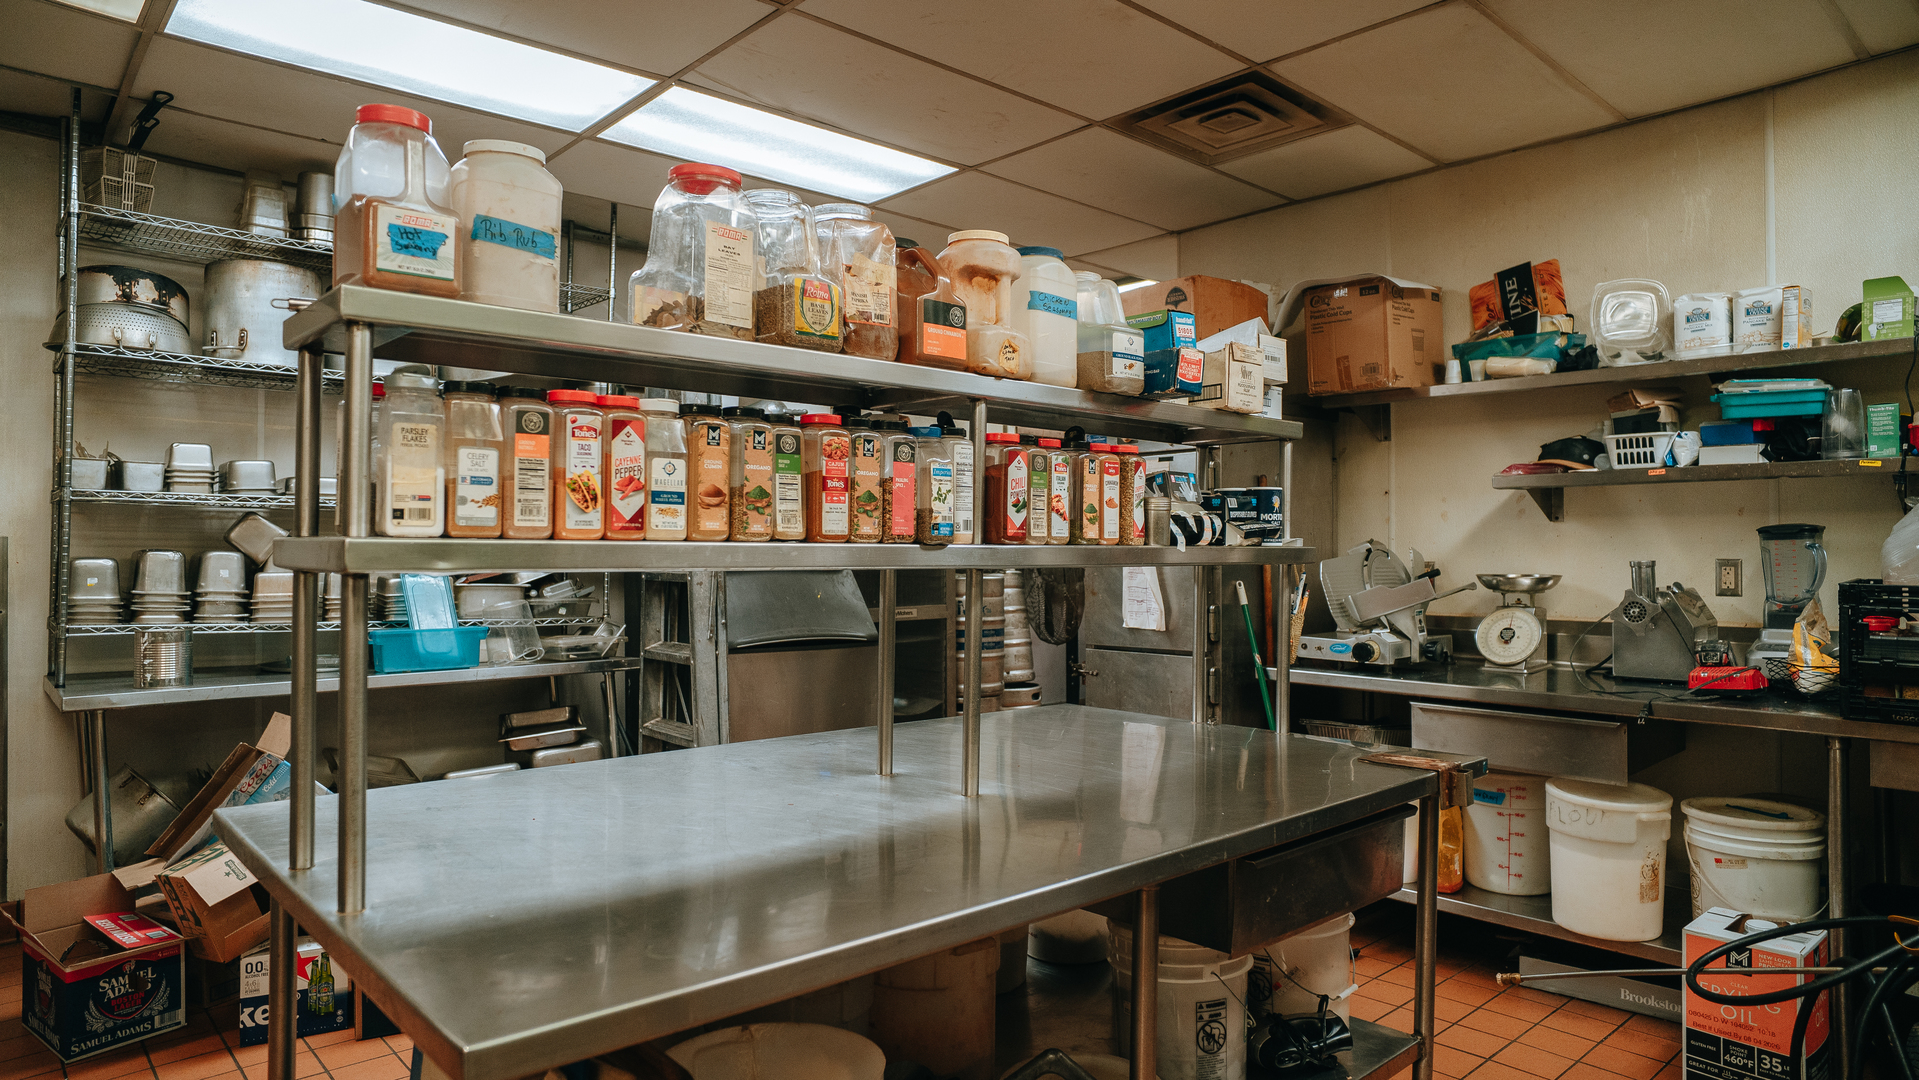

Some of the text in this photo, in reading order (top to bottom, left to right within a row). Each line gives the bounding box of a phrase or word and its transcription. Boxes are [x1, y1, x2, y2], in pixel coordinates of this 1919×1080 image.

[403, 215, 432, 228] ROMA
[398, 227, 422, 241] Hot
[480, 218, 538, 248] Rib Rub
[718, 227, 742, 241] ROMA
[718, 248, 741, 256] LEAVES
[806, 286, 829, 300] Roma
[807, 307, 829, 315] LEAVES
[1339, 309, 1352, 317] Cups
[927, 327, 962, 338] GROUND CINNAMON
[401, 427, 429, 435] PARSLEY
[573, 428, 596, 438] Tone's
[402, 435, 427, 443] FLAKES
[577, 443, 591, 451] TACO
[467, 452, 489, 460] CELERY
[614, 455, 642, 468] CAYENNE
[614, 465, 642, 480] PEPPER
[933, 468, 952, 477] Imperial
[654, 478, 684, 487] MAGELLAN
[827, 480, 845, 488] Tone's
[1010, 476, 1026, 490] CHILI
[1010, 489, 1026, 499] POWDER
[240, 758, 273, 793] Coors
[247, 764, 274, 794] LIGHT
[262, 776, 278, 793] Cold
[1774, 956, 1792, 965] LOOK
[104, 979, 152, 1003] ADAS
[1730, 981, 1749, 990] CLEAR
[111, 991, 145, 1006] BOSTON
[114, 999, 142, 1012] LAGER
[1720, 1004, 1758, 1027] OIL
[70, 1021, 152, 1055] SAMUEL ADAMS
[1692, 1020, 1707, 1030] Best
[1713, 1025, 1733, 1037] Used
[1733, 1030, 1742, 1041] By
[1753, 1036, 1762, 1045] 04
[1763, 1039, 1781, 1050] 2026
[1757, 1026, 1776, 1038] 10:18
[1690, 1039, 1706, 1048] GLUTEN
[1729, 1045, 1748, 1054] SMOKE
[1730, 1050, 1747, 1058] POINT
[1688, 1059, 1718, 1074] GREAT FOR
[1760, 1054, 1782, 1072] 35
